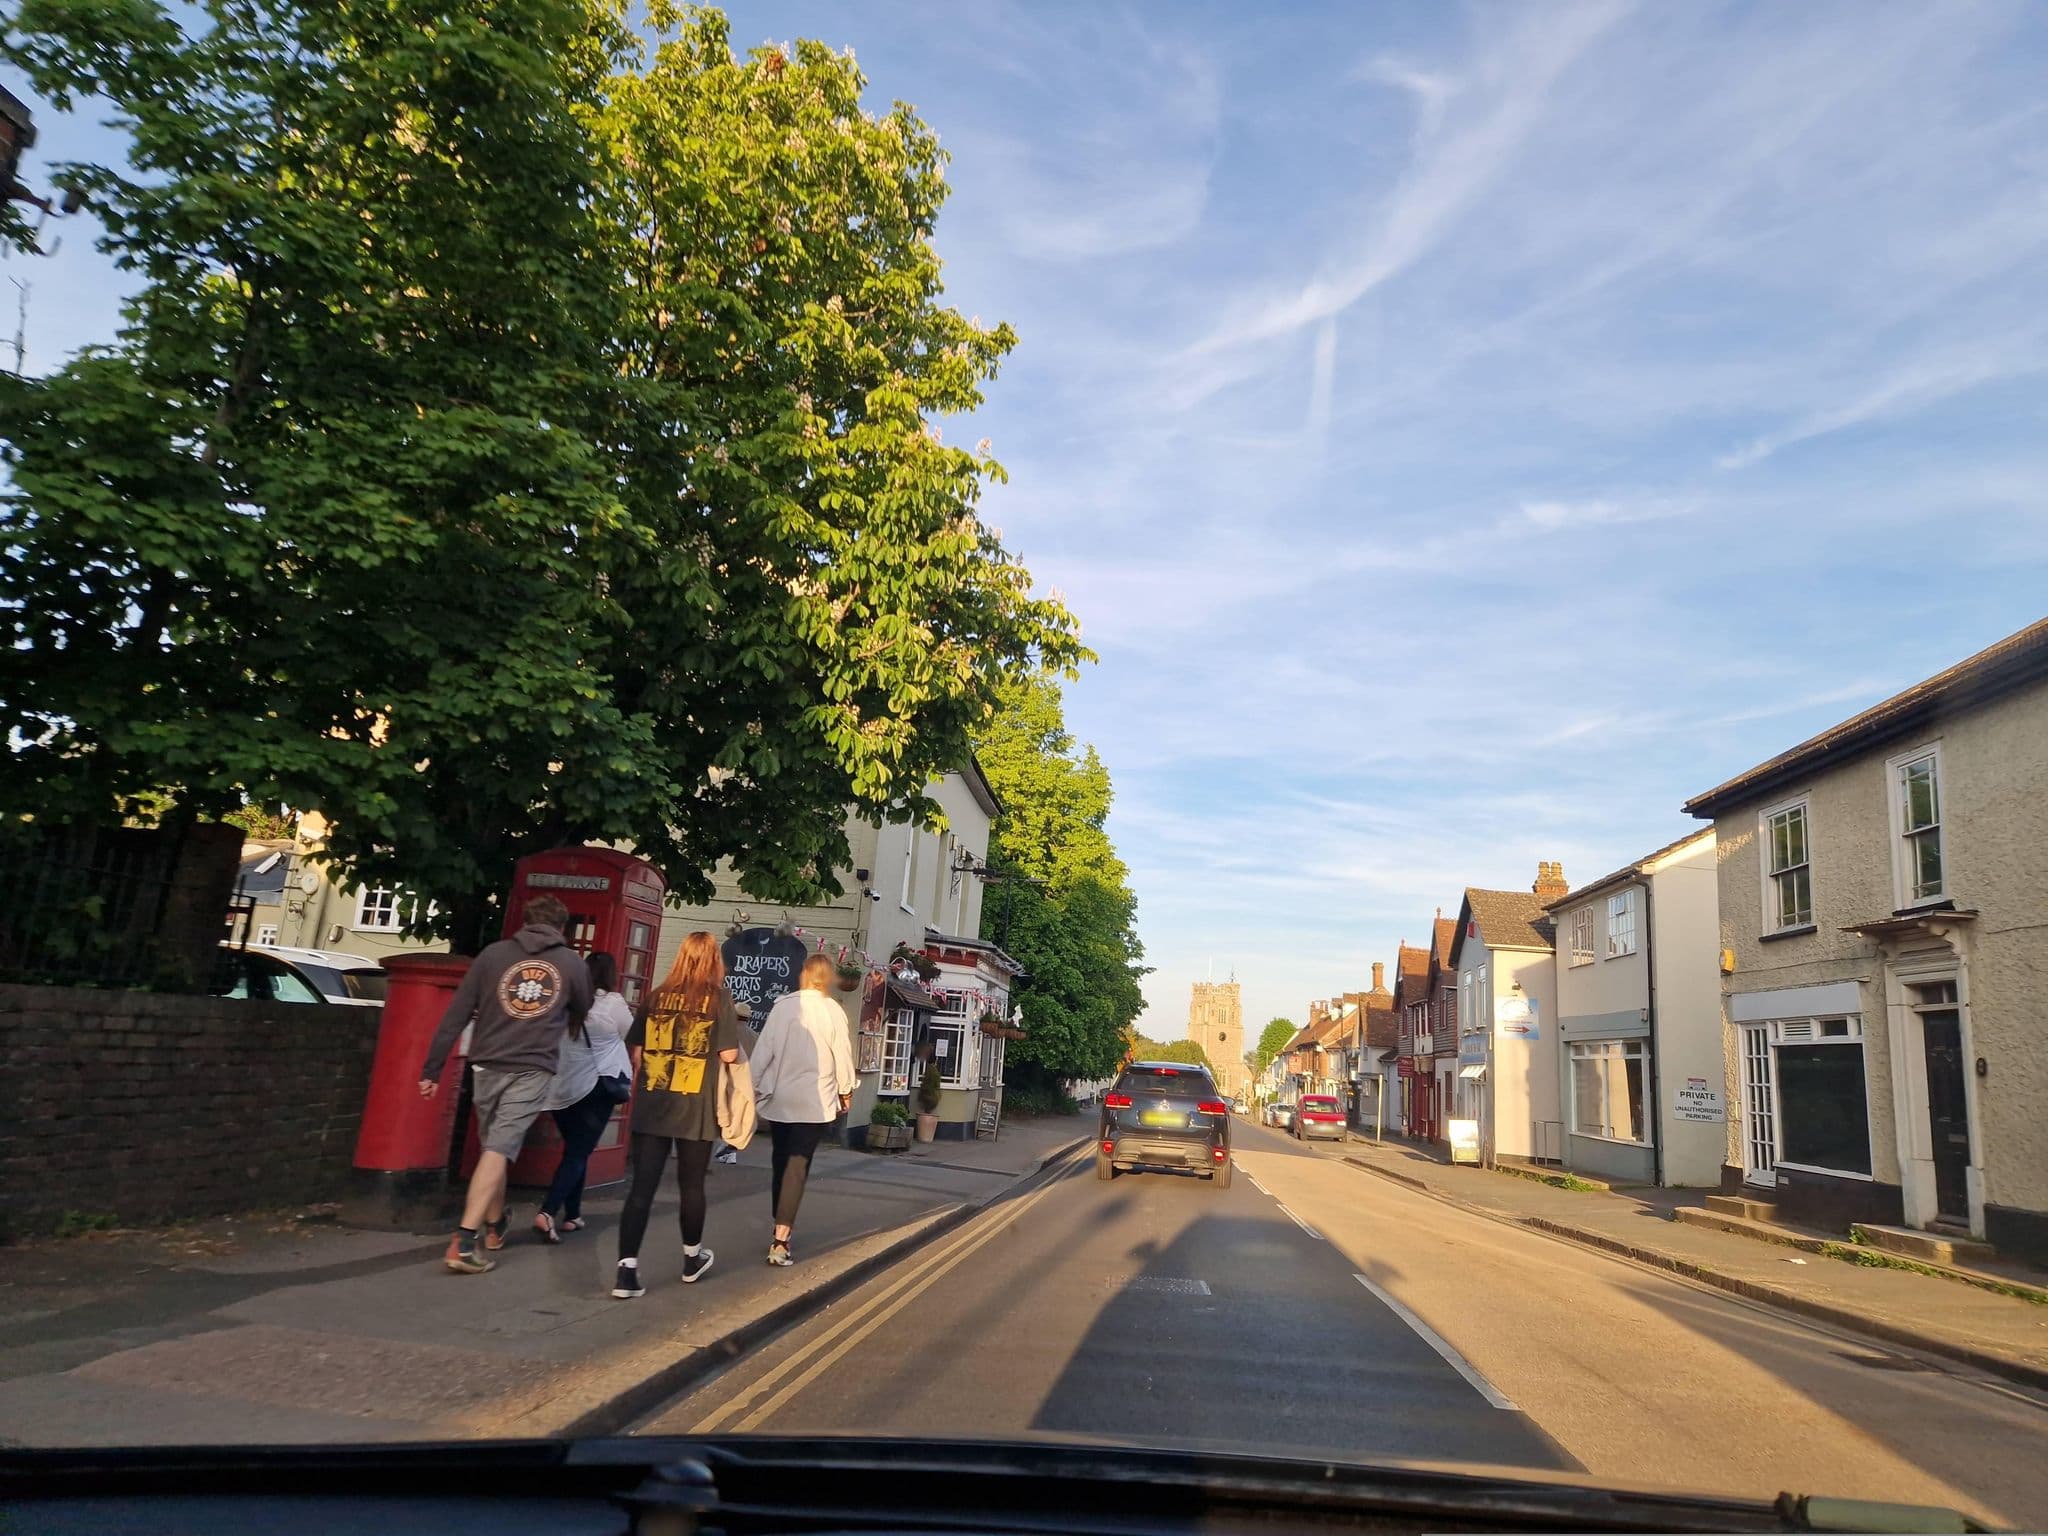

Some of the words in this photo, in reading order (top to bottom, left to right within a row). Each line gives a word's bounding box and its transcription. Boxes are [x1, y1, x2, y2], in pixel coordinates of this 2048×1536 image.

[734, 954, 790, 977] DRAPERS
[723, 975, 761, 991] SPORTS
[731, 988, 762, 1004] BAR
[1679, 1091, 1716, 1100] PRIVATE
[1674, 1105, 1723, 1115] UNAUTHORISED
[1685, 1112, 1713, 1121] PARKING
